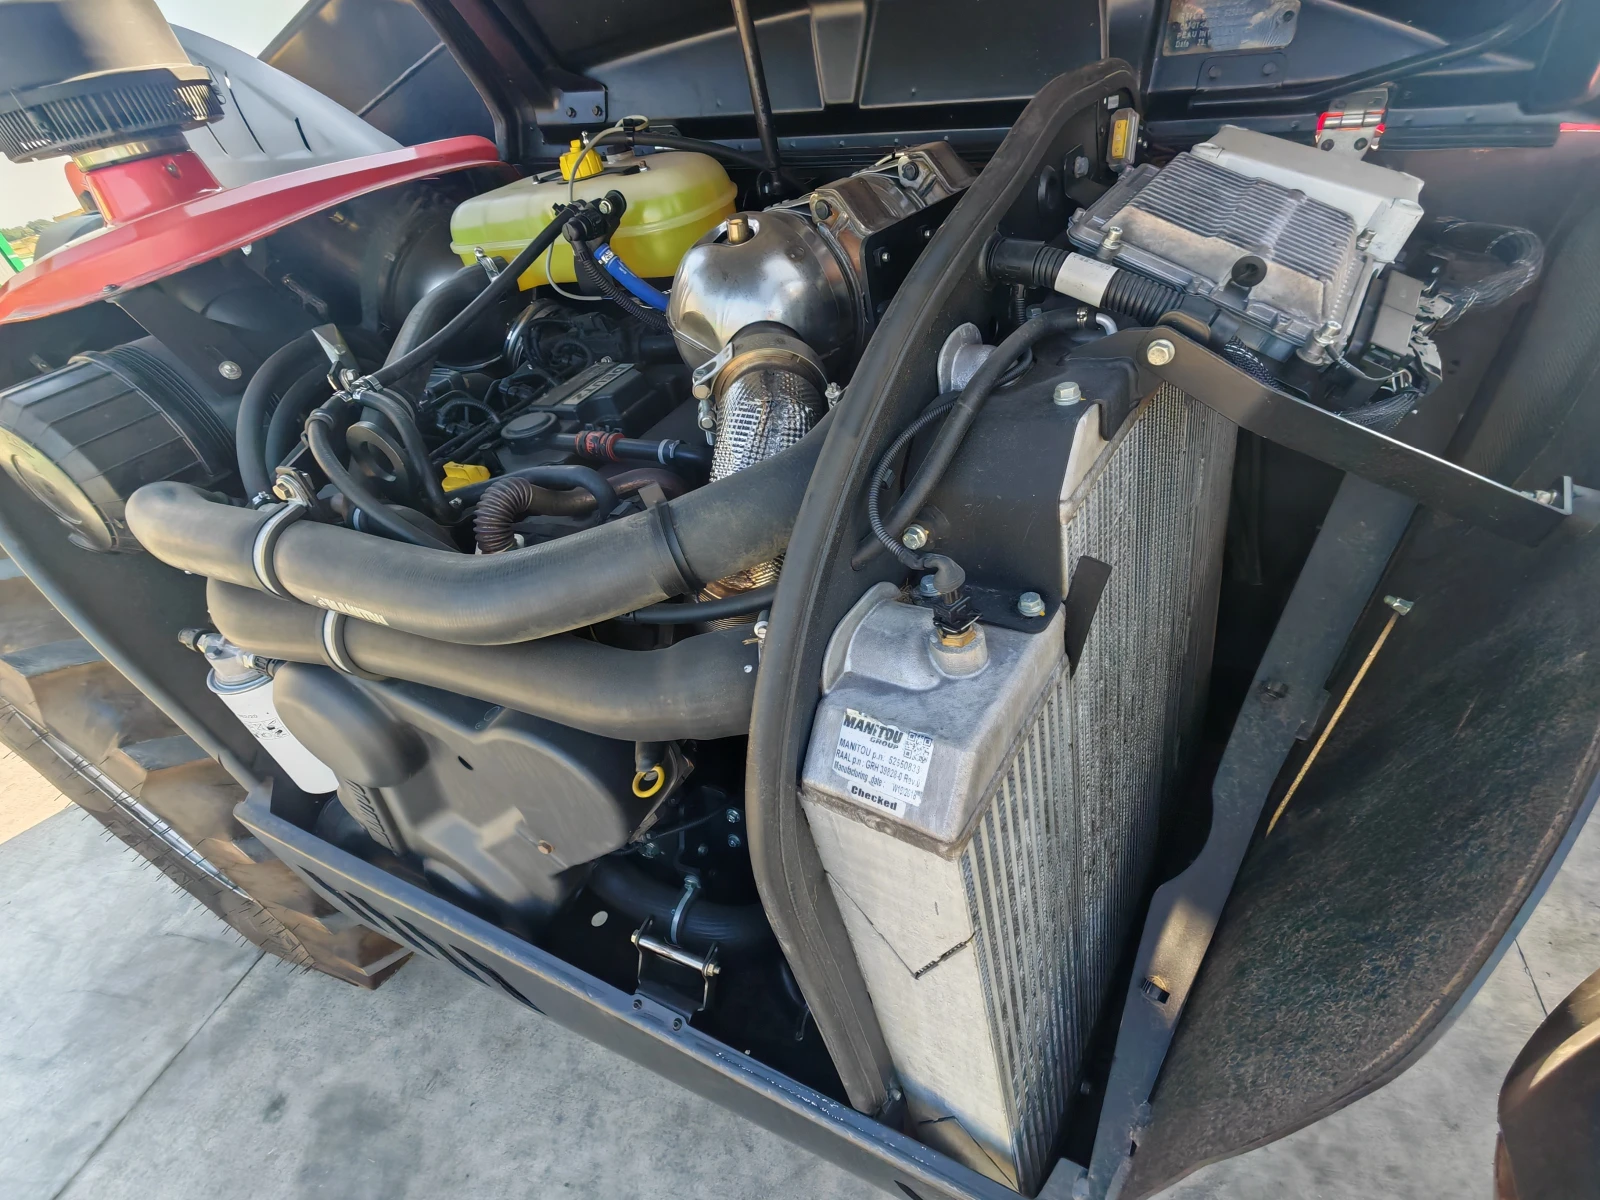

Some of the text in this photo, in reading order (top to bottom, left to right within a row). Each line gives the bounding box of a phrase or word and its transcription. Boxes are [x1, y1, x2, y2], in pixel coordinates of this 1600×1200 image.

[843, 714, 904, 744] MANITOU
[839, 738, 872, 756] MANITOU
[870, 737, 898, 749] GROUP
[834, 761, 868, 782] Manufacturing
[836, 749, 851, 762] RAAL
[866, 760, 879, 772] GRH
[851, 785, 897, 811] Checked
